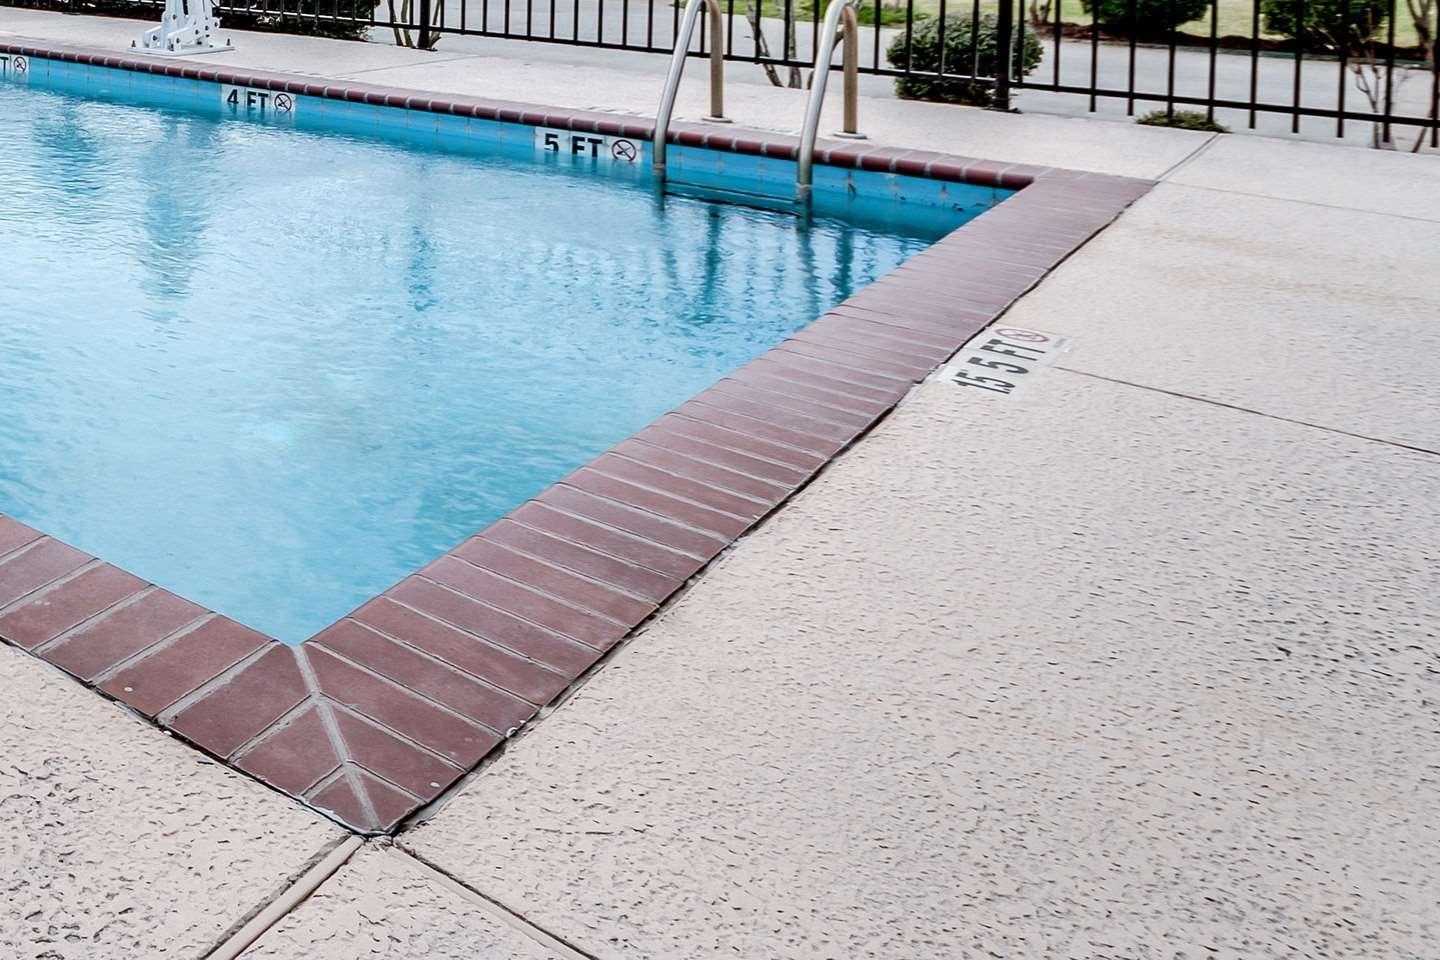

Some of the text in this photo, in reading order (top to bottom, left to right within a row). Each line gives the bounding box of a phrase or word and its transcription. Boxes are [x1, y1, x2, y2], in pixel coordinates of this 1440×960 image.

[227, 89, 269, 108] 4 FT
[544, 133, 603, 157] 5 FT
[980, 339, 1046, 361] FT
[967, 357, 1029, 374] 5
